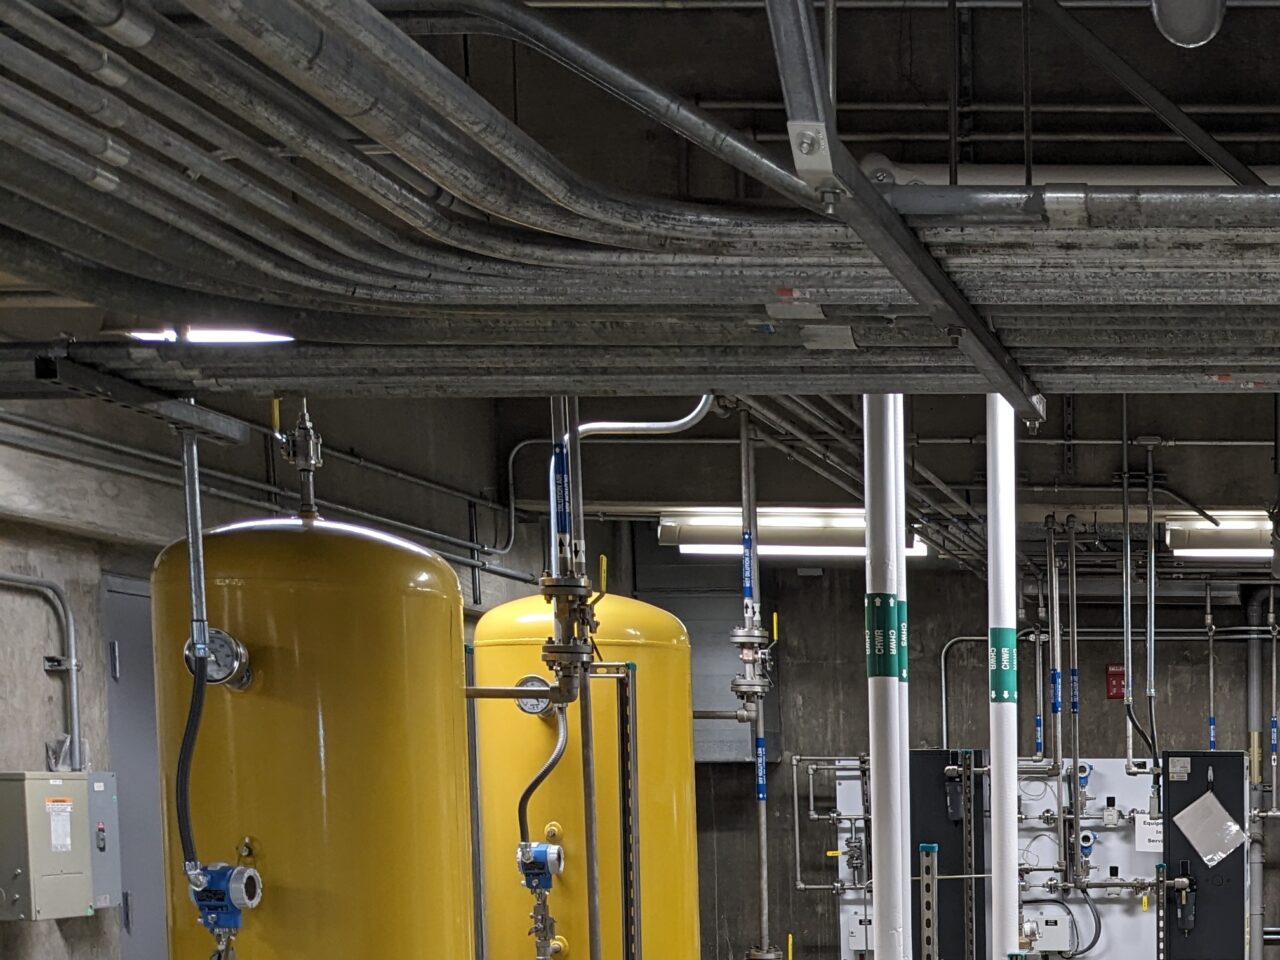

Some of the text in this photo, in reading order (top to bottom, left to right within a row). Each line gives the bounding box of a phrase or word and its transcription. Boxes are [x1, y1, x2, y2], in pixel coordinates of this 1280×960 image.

[874, 629, 884, 655] CHWR
[888, 629, 897, 655] CHWR
[1001, 647, 1010, 670] CHWR
